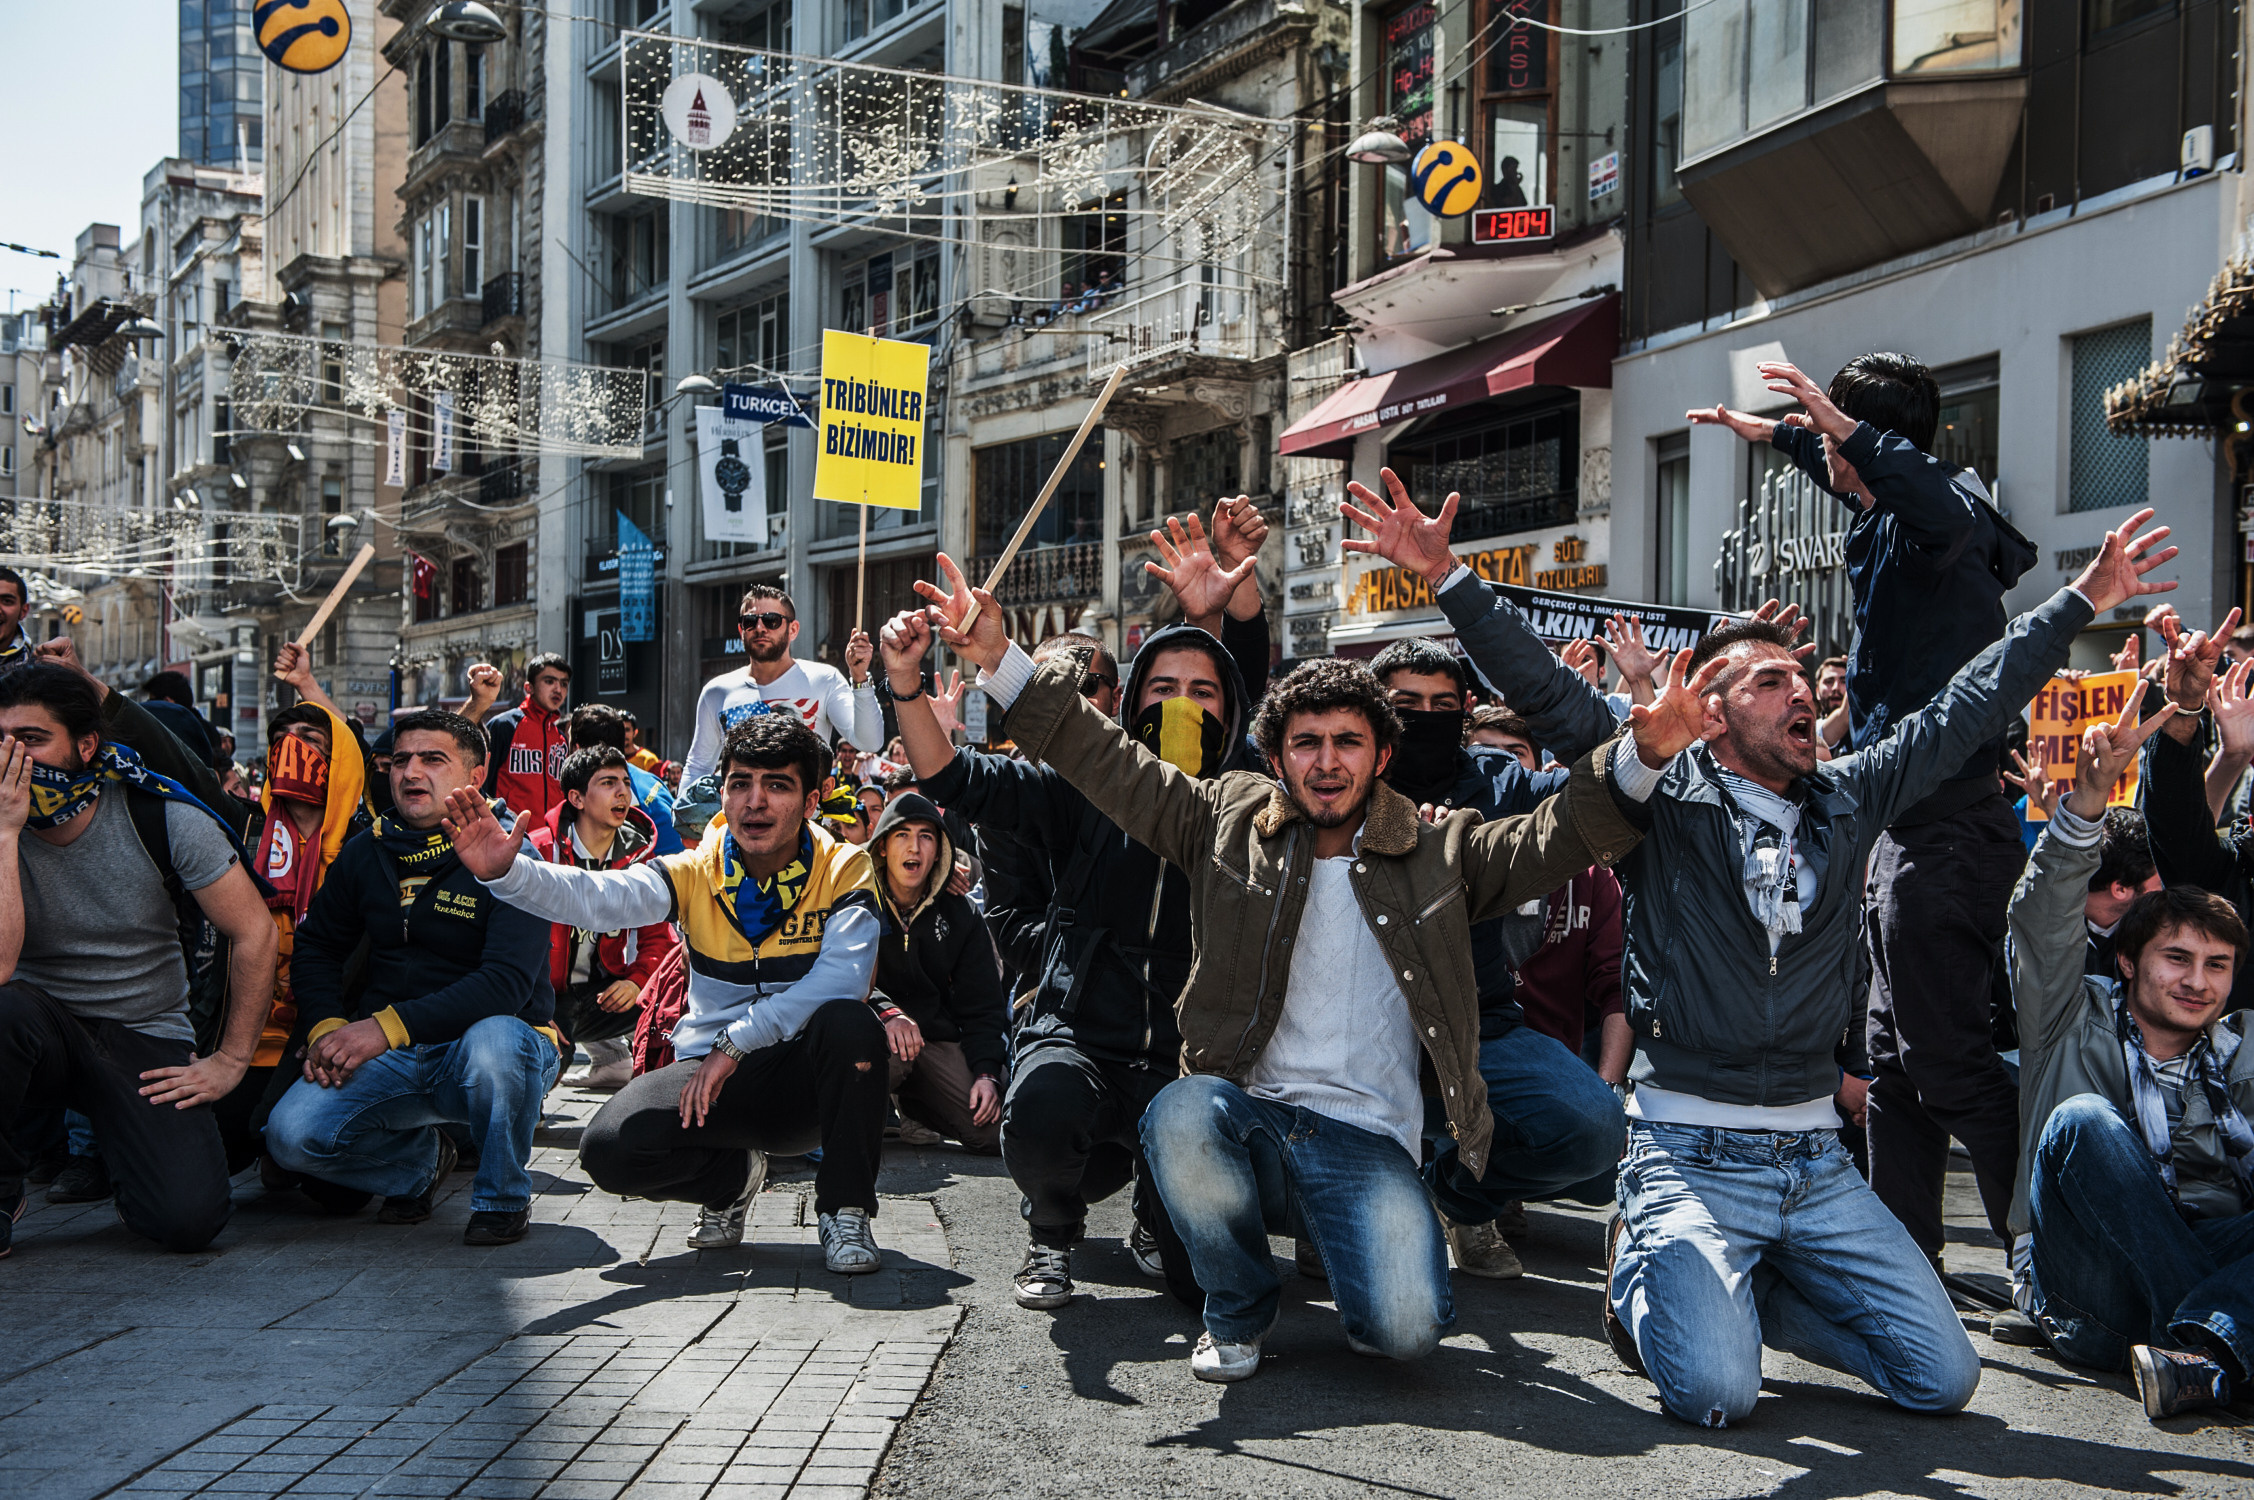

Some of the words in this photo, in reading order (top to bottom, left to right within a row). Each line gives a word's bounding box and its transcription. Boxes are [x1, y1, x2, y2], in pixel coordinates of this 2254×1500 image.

[1489, 211, 1547, 239] 1304
[729, 393, 803, 418] TURKCEL
[824, 376, 922, 422] TRİBÜNLER
[826, 420, 915, 465] BİZİMDİR!
[1554, 535, 1581, 562] SÜT
[1366, 566, 1437, 613] HASA
[1535, 565, 1600, 590] TATLILARI
[1532, 596, 1577, 612] GERÇEKÇİ
[1578, 603, 1592, 612] OL
[1646, 611, 1667, 622] İSTE
[1603, 623, 1700, 653] TKIMI
[509, 748, 543, 774] RUS
